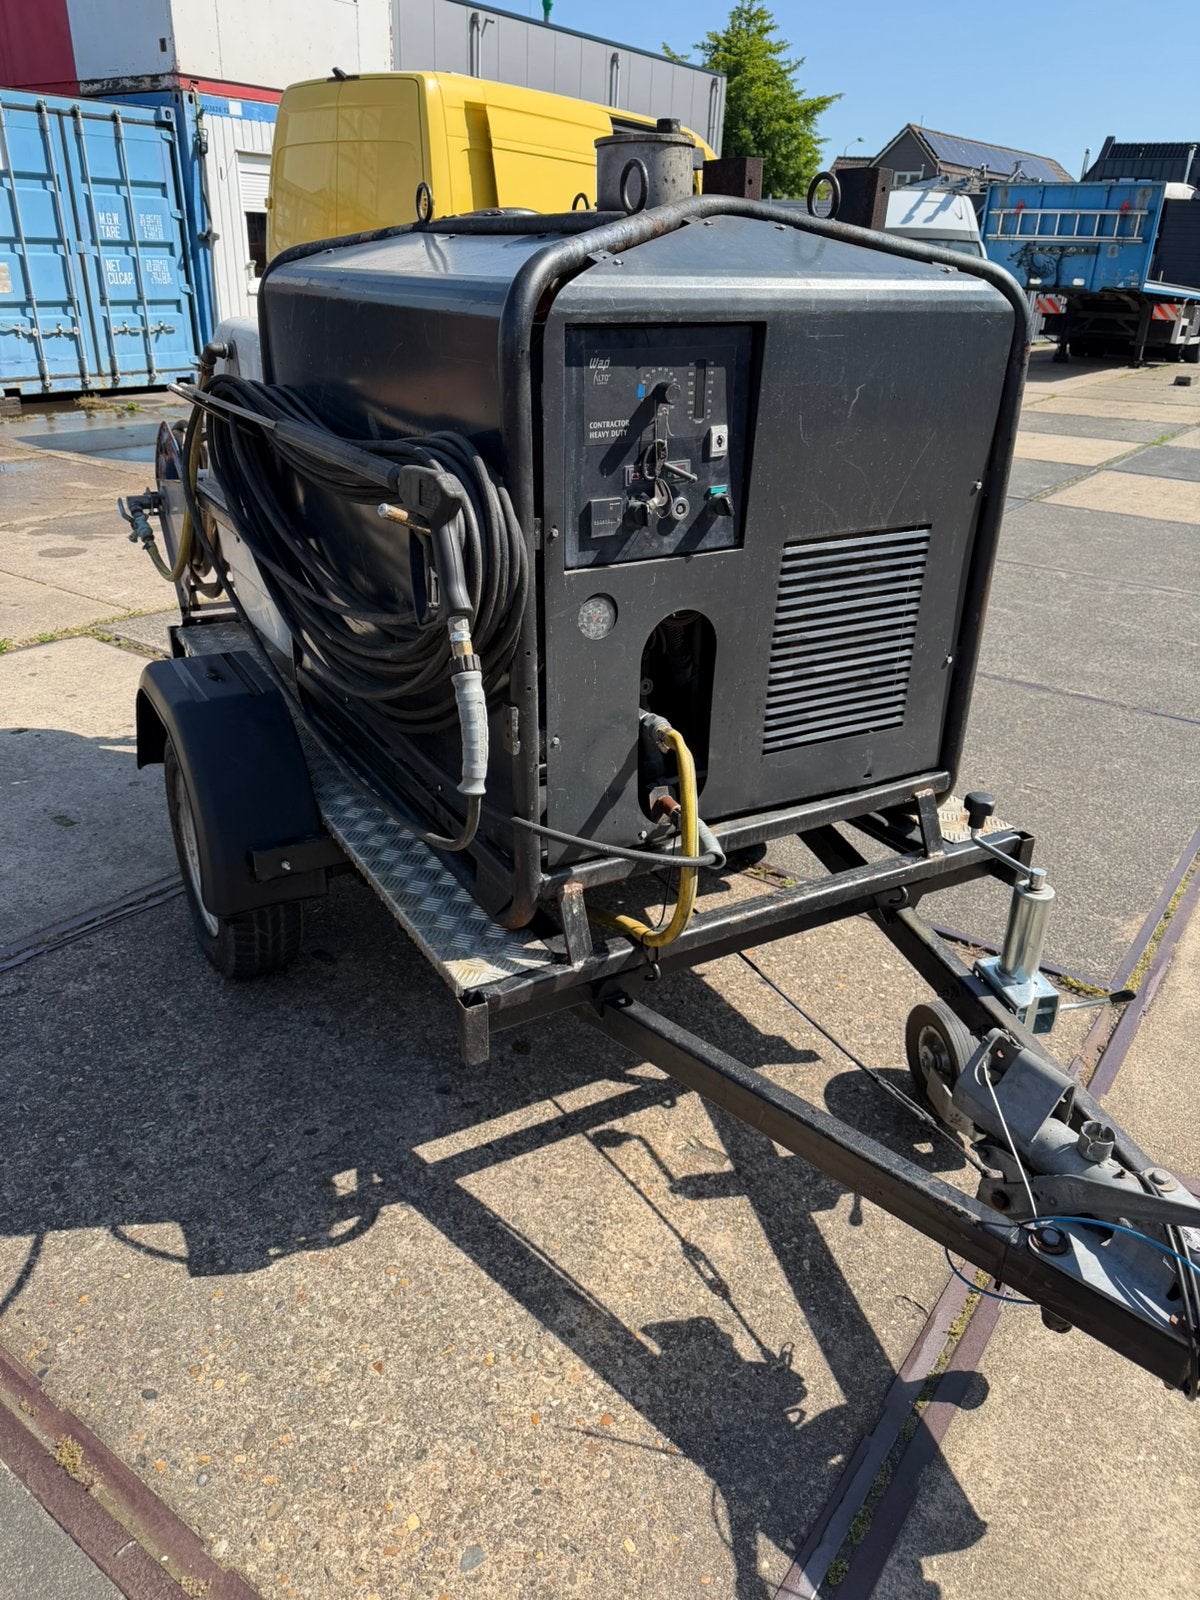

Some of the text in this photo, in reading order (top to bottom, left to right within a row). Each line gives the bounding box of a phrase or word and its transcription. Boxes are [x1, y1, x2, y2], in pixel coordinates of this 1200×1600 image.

[98, 212, 121, 225] M.G.W.
[100, 225, 121, 239] TARE
[106, 259, 120, 272] NET
[589, 419, 630, 429] CONTRACTOR
[589, 429, 628, 439] HEAVY DUTY
